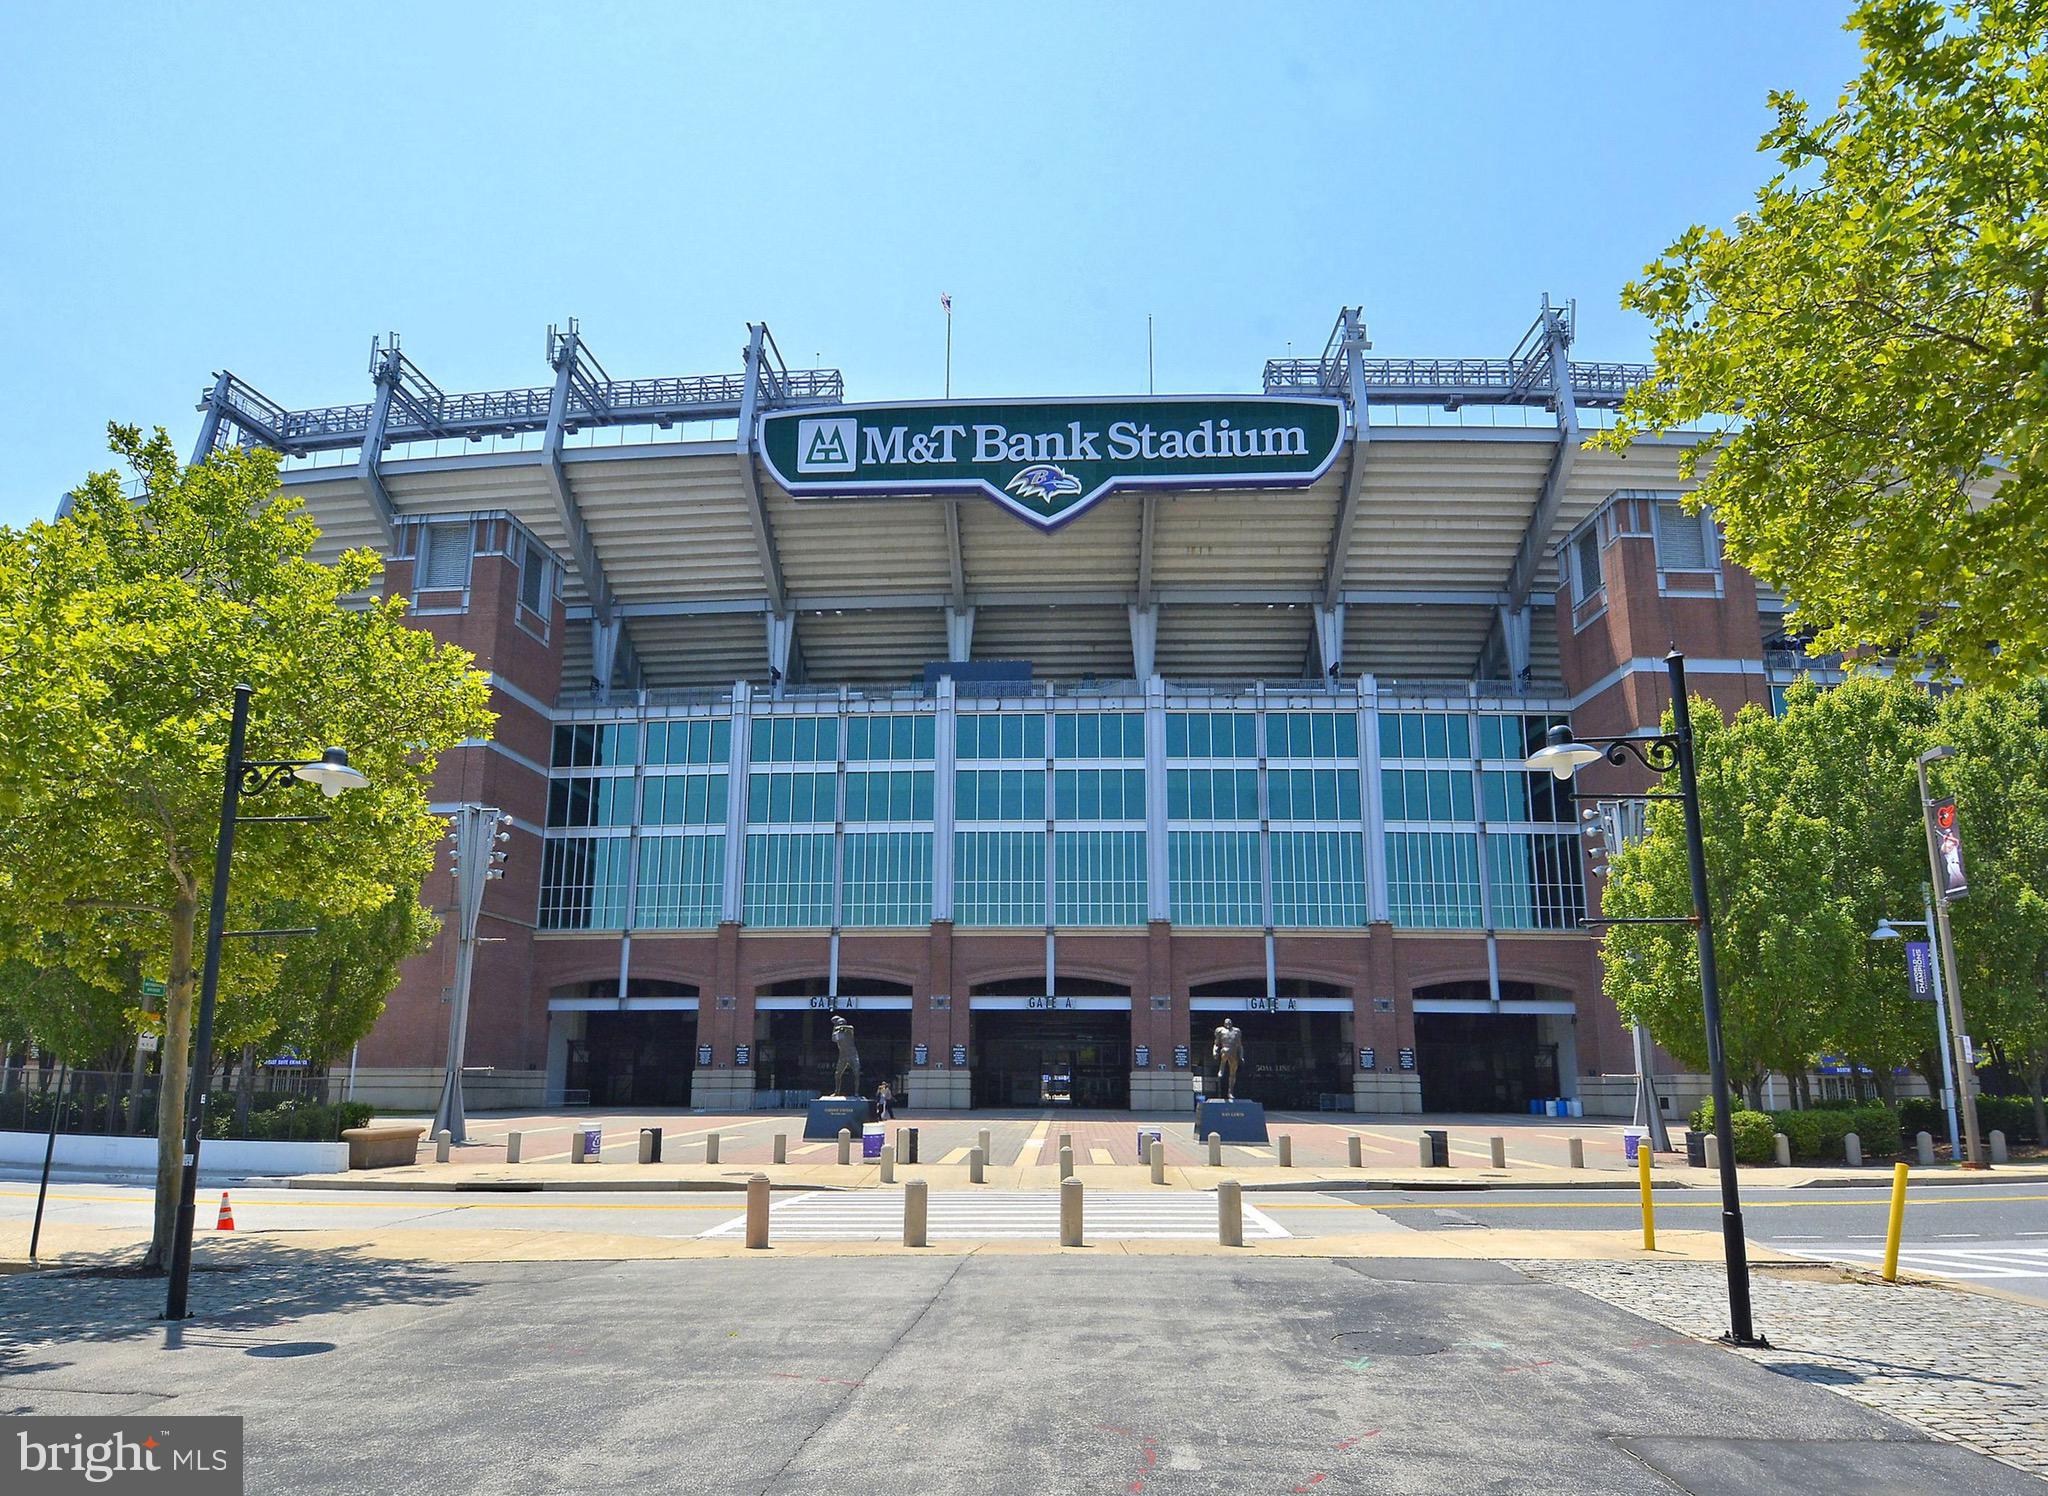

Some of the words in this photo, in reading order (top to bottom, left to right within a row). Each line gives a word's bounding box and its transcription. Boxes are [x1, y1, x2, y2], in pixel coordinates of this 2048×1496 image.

[862, 423, 966, 464] M&T
[972, 420, 1101, 463] Bank
[1107, 418, 1309, 462] Stadium
[1915, 948, 1926, 994] CHAMPIONS
[846, 997, 853, 1008] A
[1029, 996, 1057, 1008] GATE
[1065, 997, 1072, 1008] A
[1251, 998, 1279, 1010] GATE
[1287, 998, 1295, 1010] A
